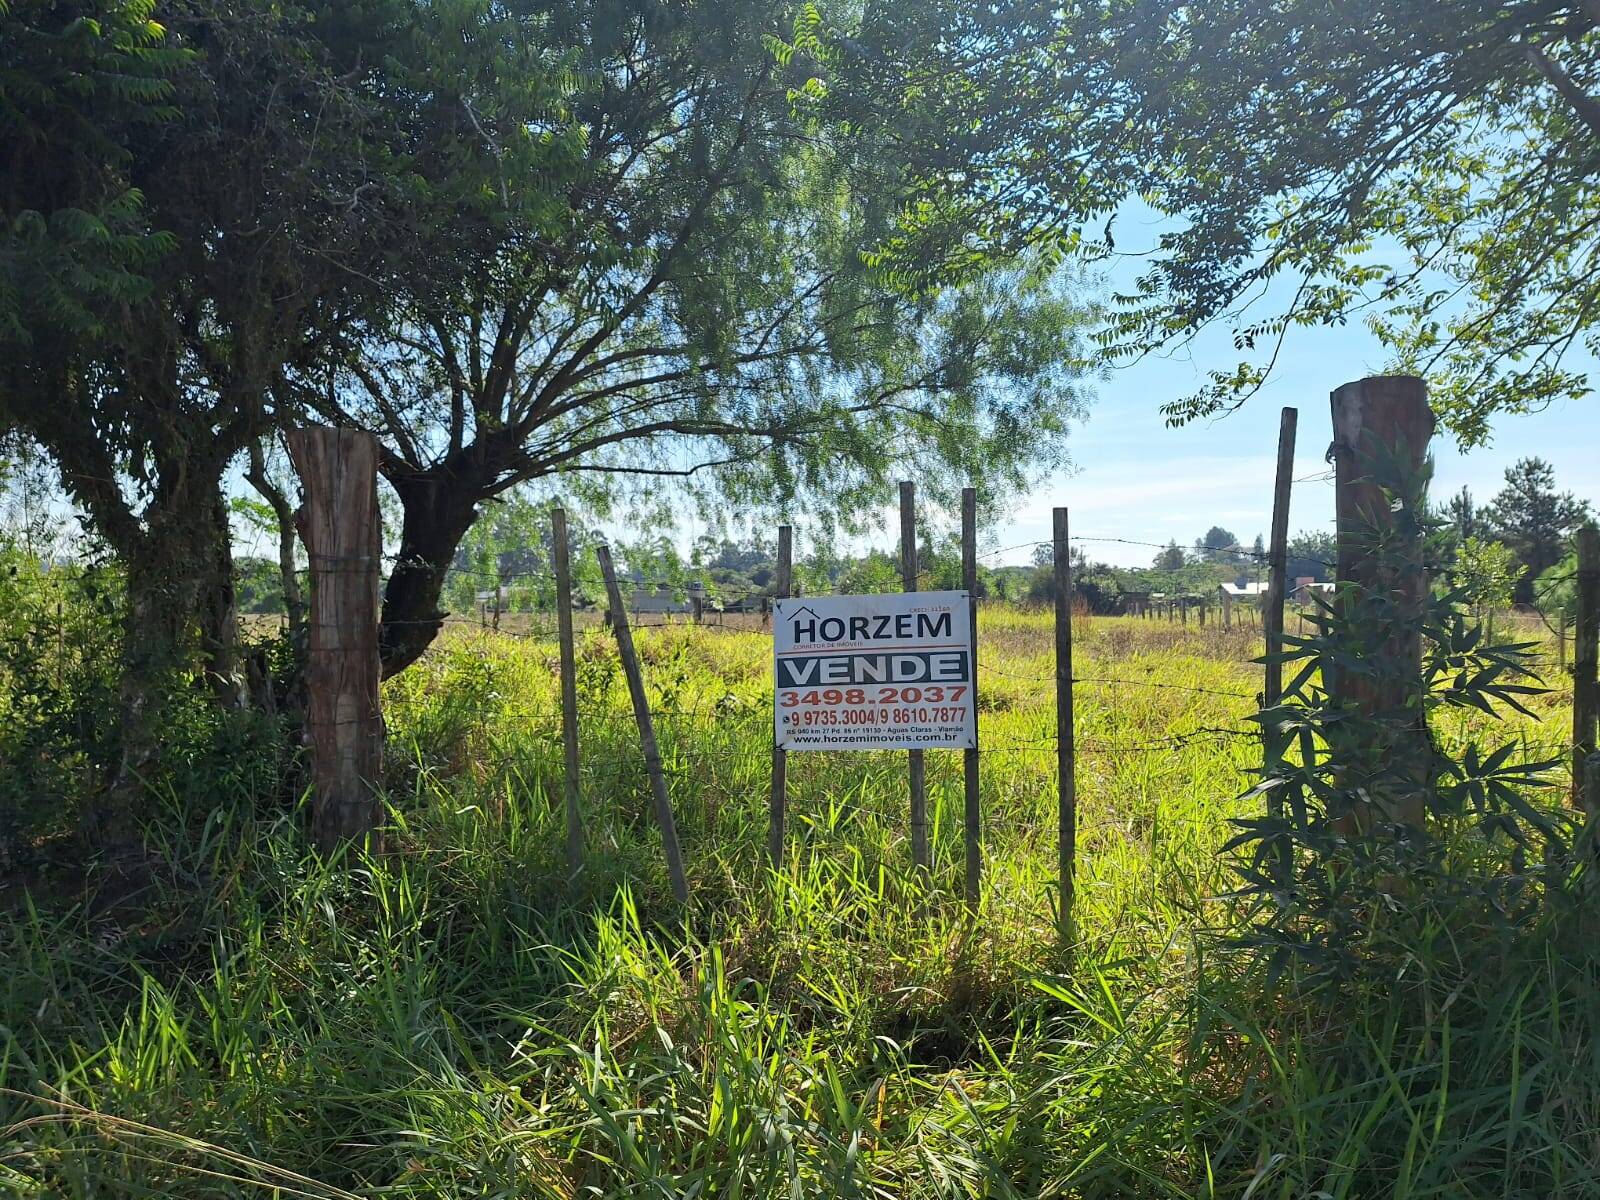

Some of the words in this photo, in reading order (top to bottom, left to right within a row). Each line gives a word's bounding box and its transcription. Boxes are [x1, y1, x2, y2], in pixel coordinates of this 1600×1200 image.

[794, 613, 951, 643] HORZEM
[783, 653, 962, 685] VENDE
[780, 687, 967, 707] 3498.2037
[893, 706, 966, 724] 8610.7877
[793, 734, 957, 743] www.horzemimoveis.com.br
